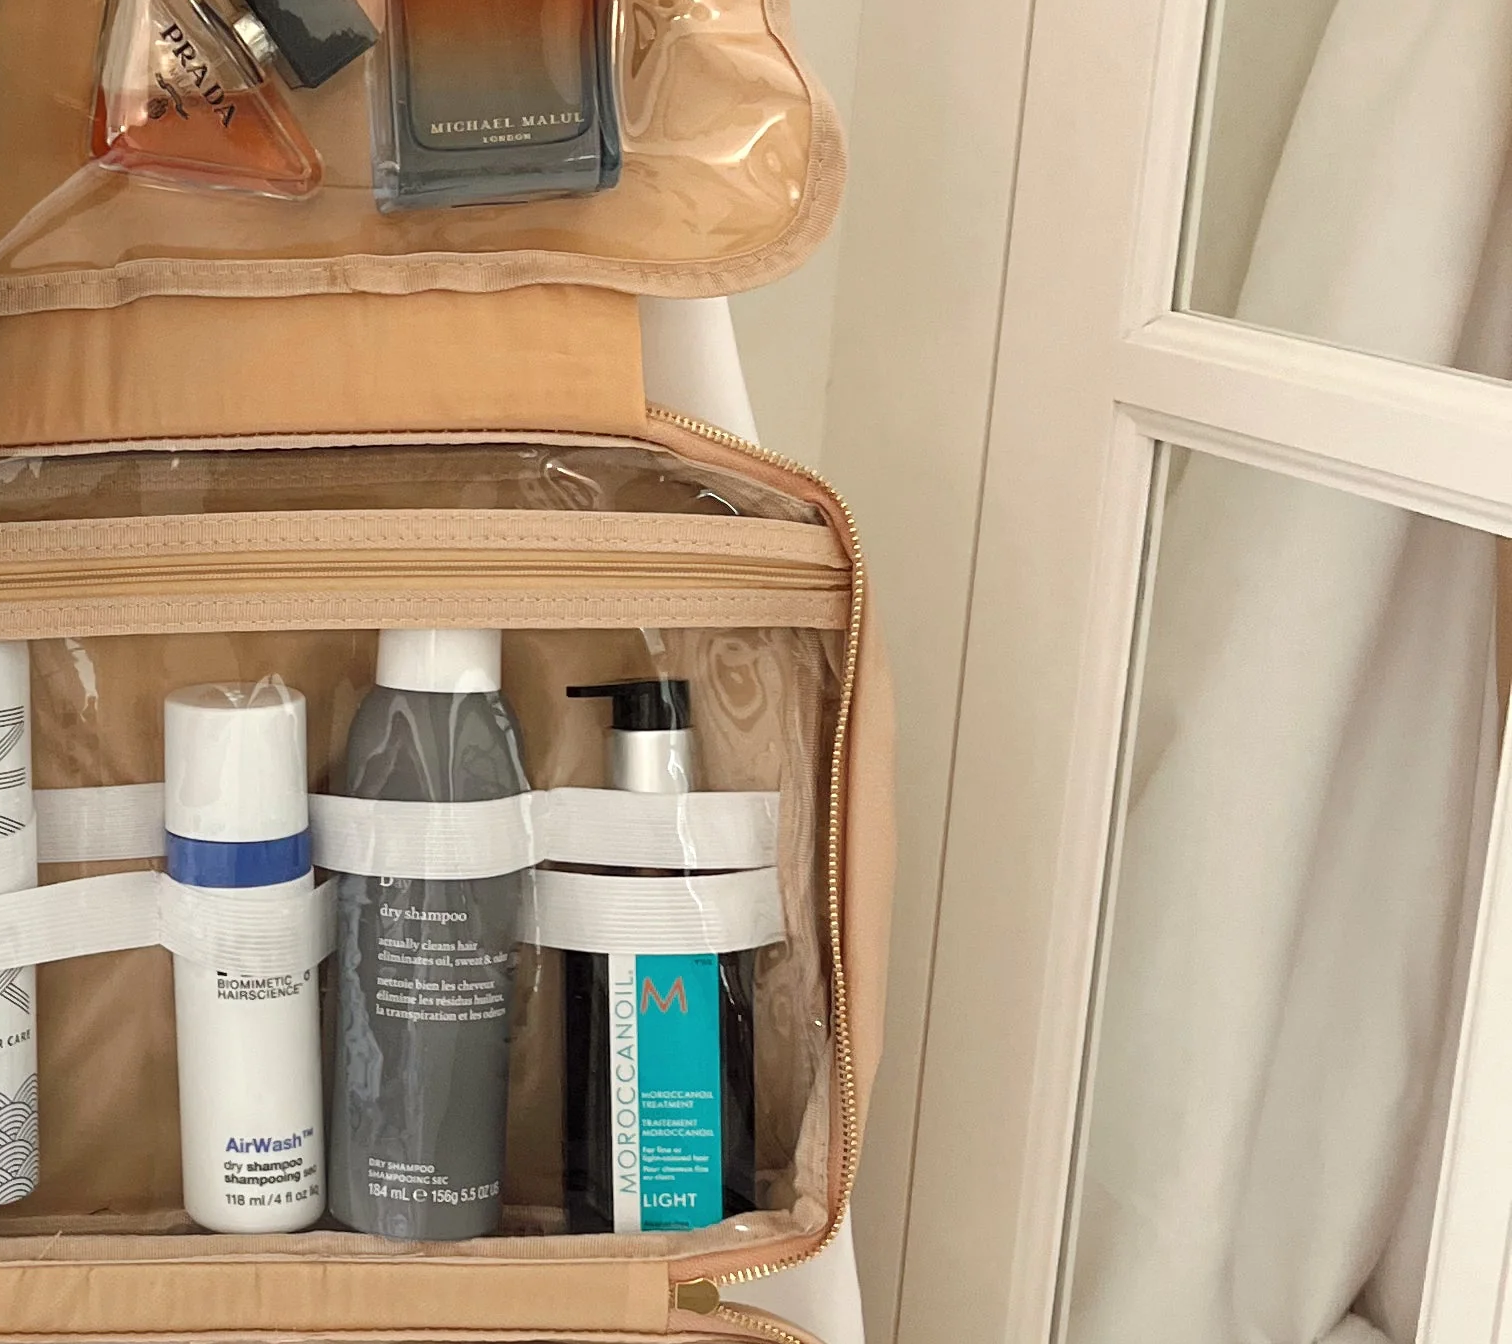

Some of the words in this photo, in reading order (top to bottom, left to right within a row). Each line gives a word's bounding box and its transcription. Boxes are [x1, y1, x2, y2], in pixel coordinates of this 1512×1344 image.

[160, 23, 236, 128] PRADA
[430, 117, 515, 134] MICHAEL
[521, 112, 585, 127] MALUL
[483, 133, 532, 144] LONDON
[379, 904, 402, 921] dry
[404, 906, 468, 924] shampoo
[378, 937, 420, 952] actually
[421, 940, 455, 951] cleans
[378, 950, 434, 966] eliminates
[217, 975, 292, 990] BIOMIMETIC
[217, 984, 301, 1000] HAIRSCIENCE
[640, 975, 688, 1014] M
[7, 1029, 31, 1047] CARE
[615, 975, 637, 1194] MOROCCANOIL
[224, 1160, 243, 1174] dry
[246, 1157, 303, 1172] shampoo
[368, 1158, 386, 1168] DRY
[388, 1161, 435, 1173] SHAMPOO
[224, 1171, 301, 1186] shampooing
[368, 1169, 430, 1185] SHAMPOOING
[432, 1176, 449, 1185] SEC
[225, 1194, 245, 1206] 118
[368, 1183, 388, 1197] 184
[390, 1187, 410, 1201] mL
[431, 1190, 459, 1205] 156g
[460, 1187, 477, 1202] 5.5
[643, 1192, 698, 1208] LIGHT
